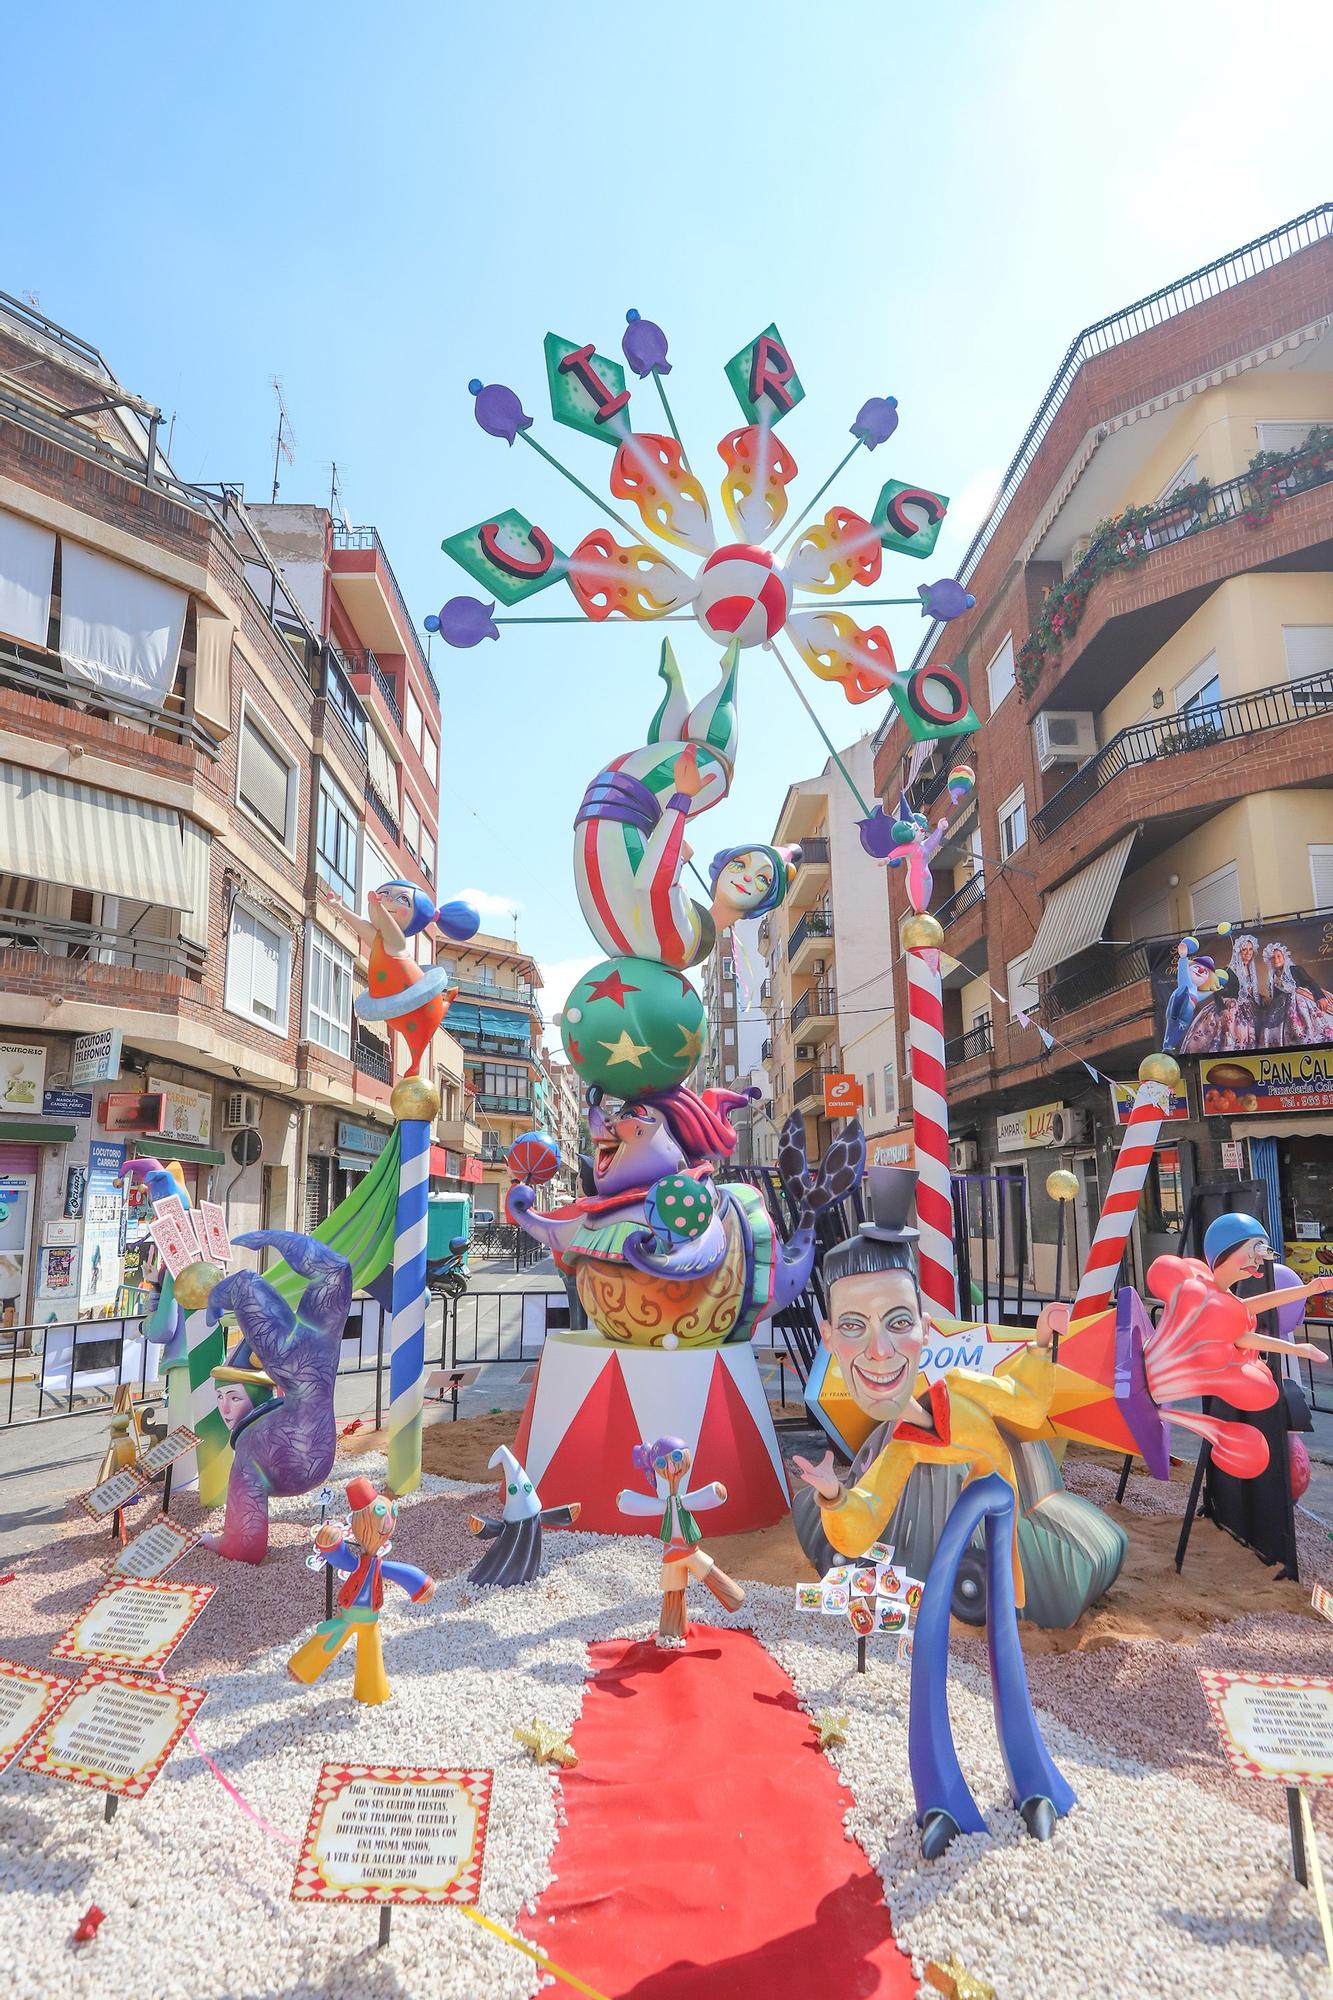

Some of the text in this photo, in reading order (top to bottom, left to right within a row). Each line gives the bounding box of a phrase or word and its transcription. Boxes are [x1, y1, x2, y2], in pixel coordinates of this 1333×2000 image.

[76, 1032, 111, 1050] LOCUTORIO
[0, 1046, 43, 1055] OCUTORIO
[75, 1045, 110, 1062] TELEFONICO
[1258, 1055, 1333, 1086] PAN CAL
[92, 1147, 121, 1158] LOCUTORIO
[918, 1345, 984, 1369] OOM
[348, 1785, 366, 1795] Elda
[403, 1787, 414, 1796] DE
[354, 1799, 369, 1807] CON
[371, 1799, 384, 1808] SUS
[386, 1800, 415, 1809] CUATRO
[341, 1811, 357, 1821] CON
[359, 1812, 368, 1821] SU
[417, 1814, 449, 1823] CULTURA
[452, 1815, 456, 1823] Y
[390, 1826, 412, 1836] PERO
[415, 1827, 440, 1836] TODAS
[442, 1827, 457, 1837] CON
[357, 1839, 372, 1849] UNA
[374, 1840, 399, 1849] MISMA
[324, 1852, 458, 1864] A VER SI EL ALCALDE AÑADE EN SU
[360, 1868, 417, 1878] AGENDA 2030
